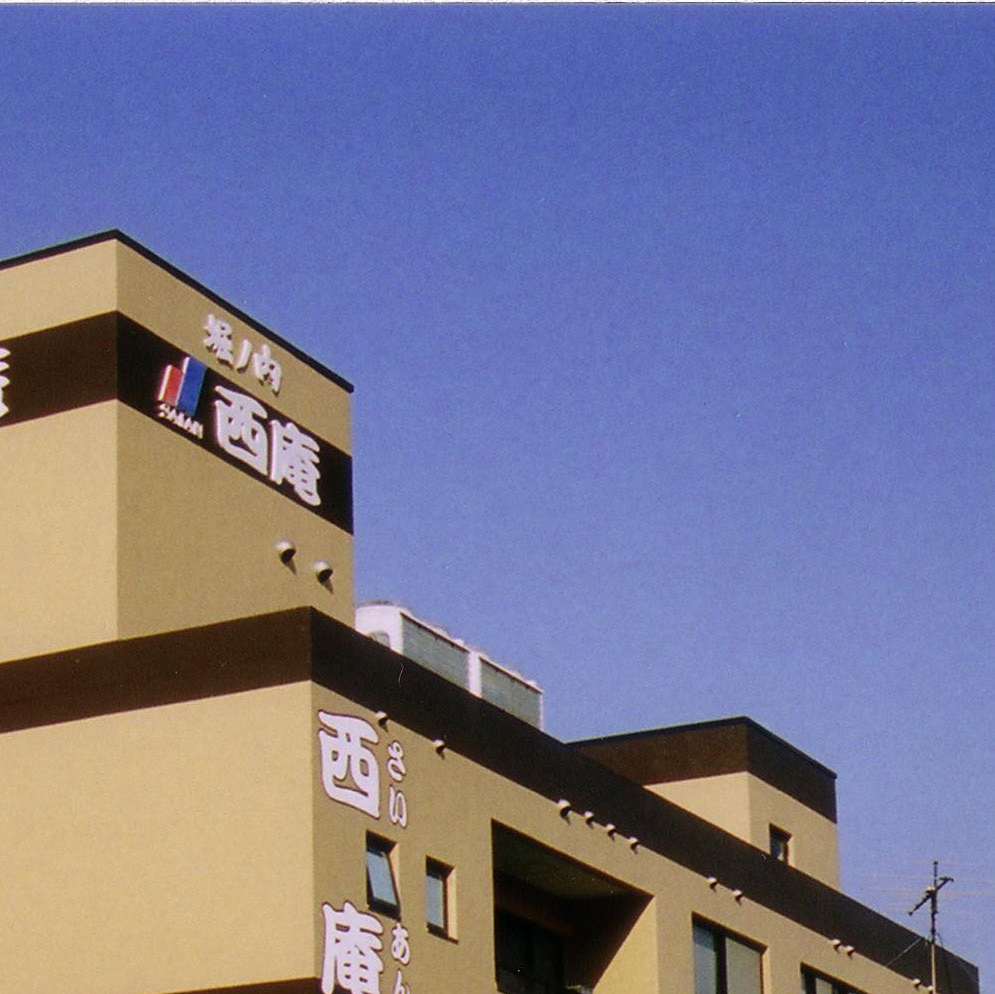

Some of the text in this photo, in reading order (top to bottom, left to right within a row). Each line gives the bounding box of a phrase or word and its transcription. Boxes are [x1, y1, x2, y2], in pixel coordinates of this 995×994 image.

[203, 314, 282, 396] 堀ノ内
[214, 385, 322, 507] 西庵
